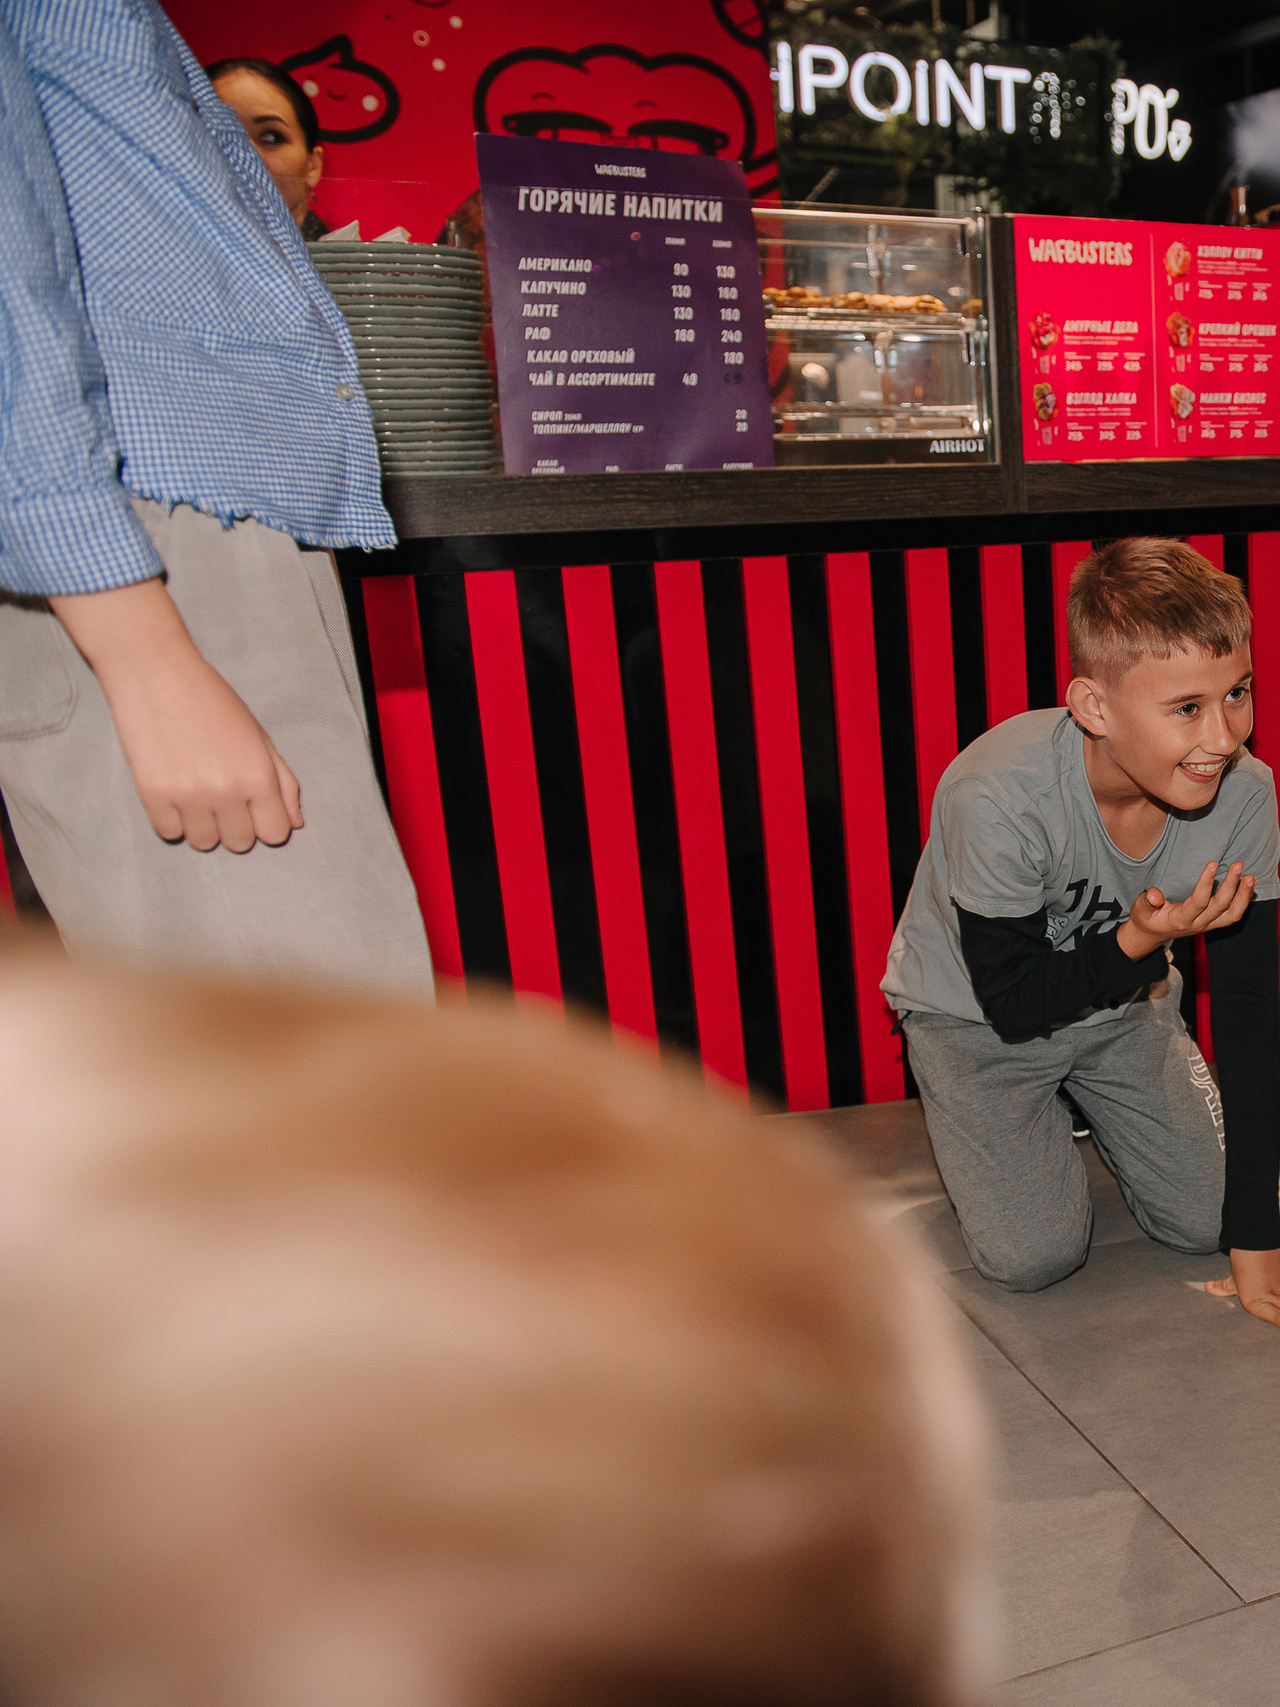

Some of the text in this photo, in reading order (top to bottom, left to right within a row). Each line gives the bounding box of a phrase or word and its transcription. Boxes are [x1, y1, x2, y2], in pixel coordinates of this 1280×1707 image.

[518, 188, 723, 223] ГОРЯЧИЕ НАПИТКИ
[1028, 237, 1133, 266] WAFBUSTERS
[518, 257, 593, 273] АМЕРИКАНО
[673, 263, 736, 279] 90 130
[521, 280, 587, 295] КАПУЧИНО
[671, 284, 692, 298] 130
[522, 303, 559, 318] ЛАТТЕ
[673, 306, 694, 320] 130
[525, 326, 551, 341] РАФ
[721, 330, 742, 343] 240
[527, 348, 635, 364] КАКАО ОРЕХОВЫЙ
[529, 371, 656, 387] ЧАЙ В АССОРТИМЕНТЕ
[532, 411, 564, 422] СИРОП
[735, 409, 748, 419] 20
[736, 422, 748, 432] 20
[930, 439, 986, 453] AIRHOT
